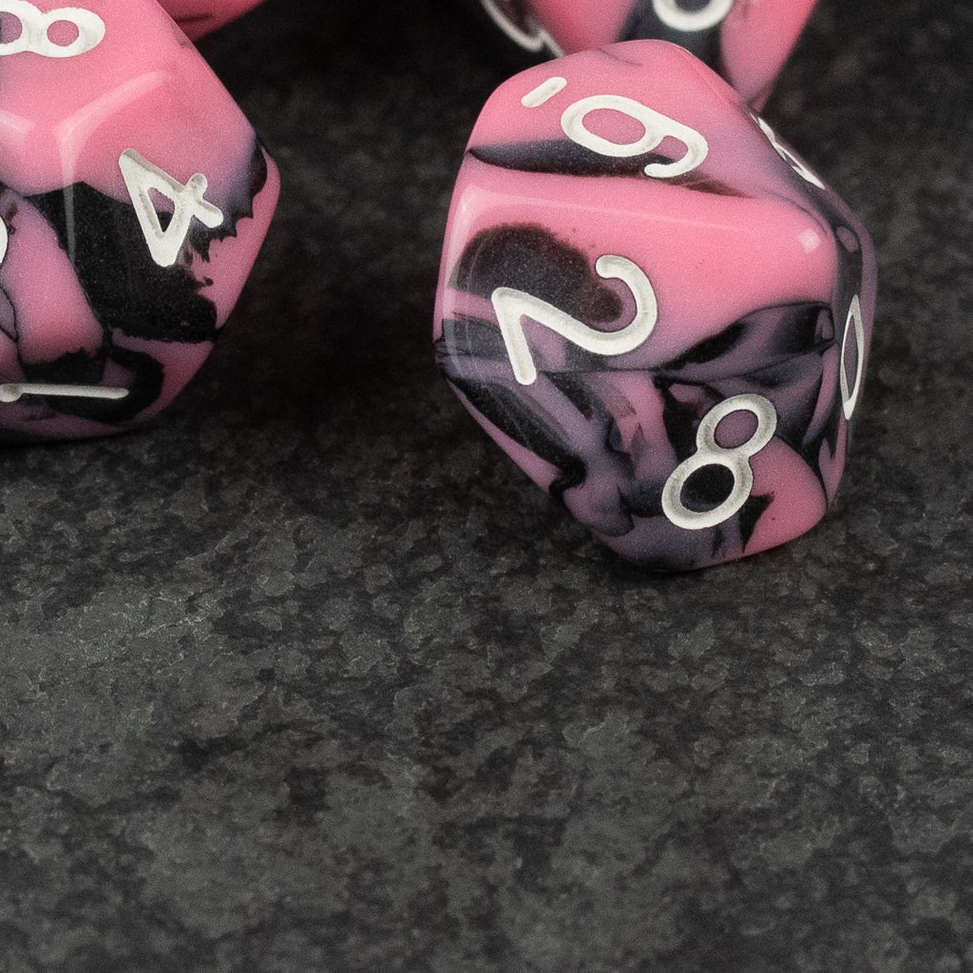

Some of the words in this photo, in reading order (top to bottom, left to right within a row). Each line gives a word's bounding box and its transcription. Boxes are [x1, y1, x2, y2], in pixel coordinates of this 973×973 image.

[118, 148, 225, 268] 4
[490, 254, 658, 386] 2
[661, 393, 778, 531] 8
